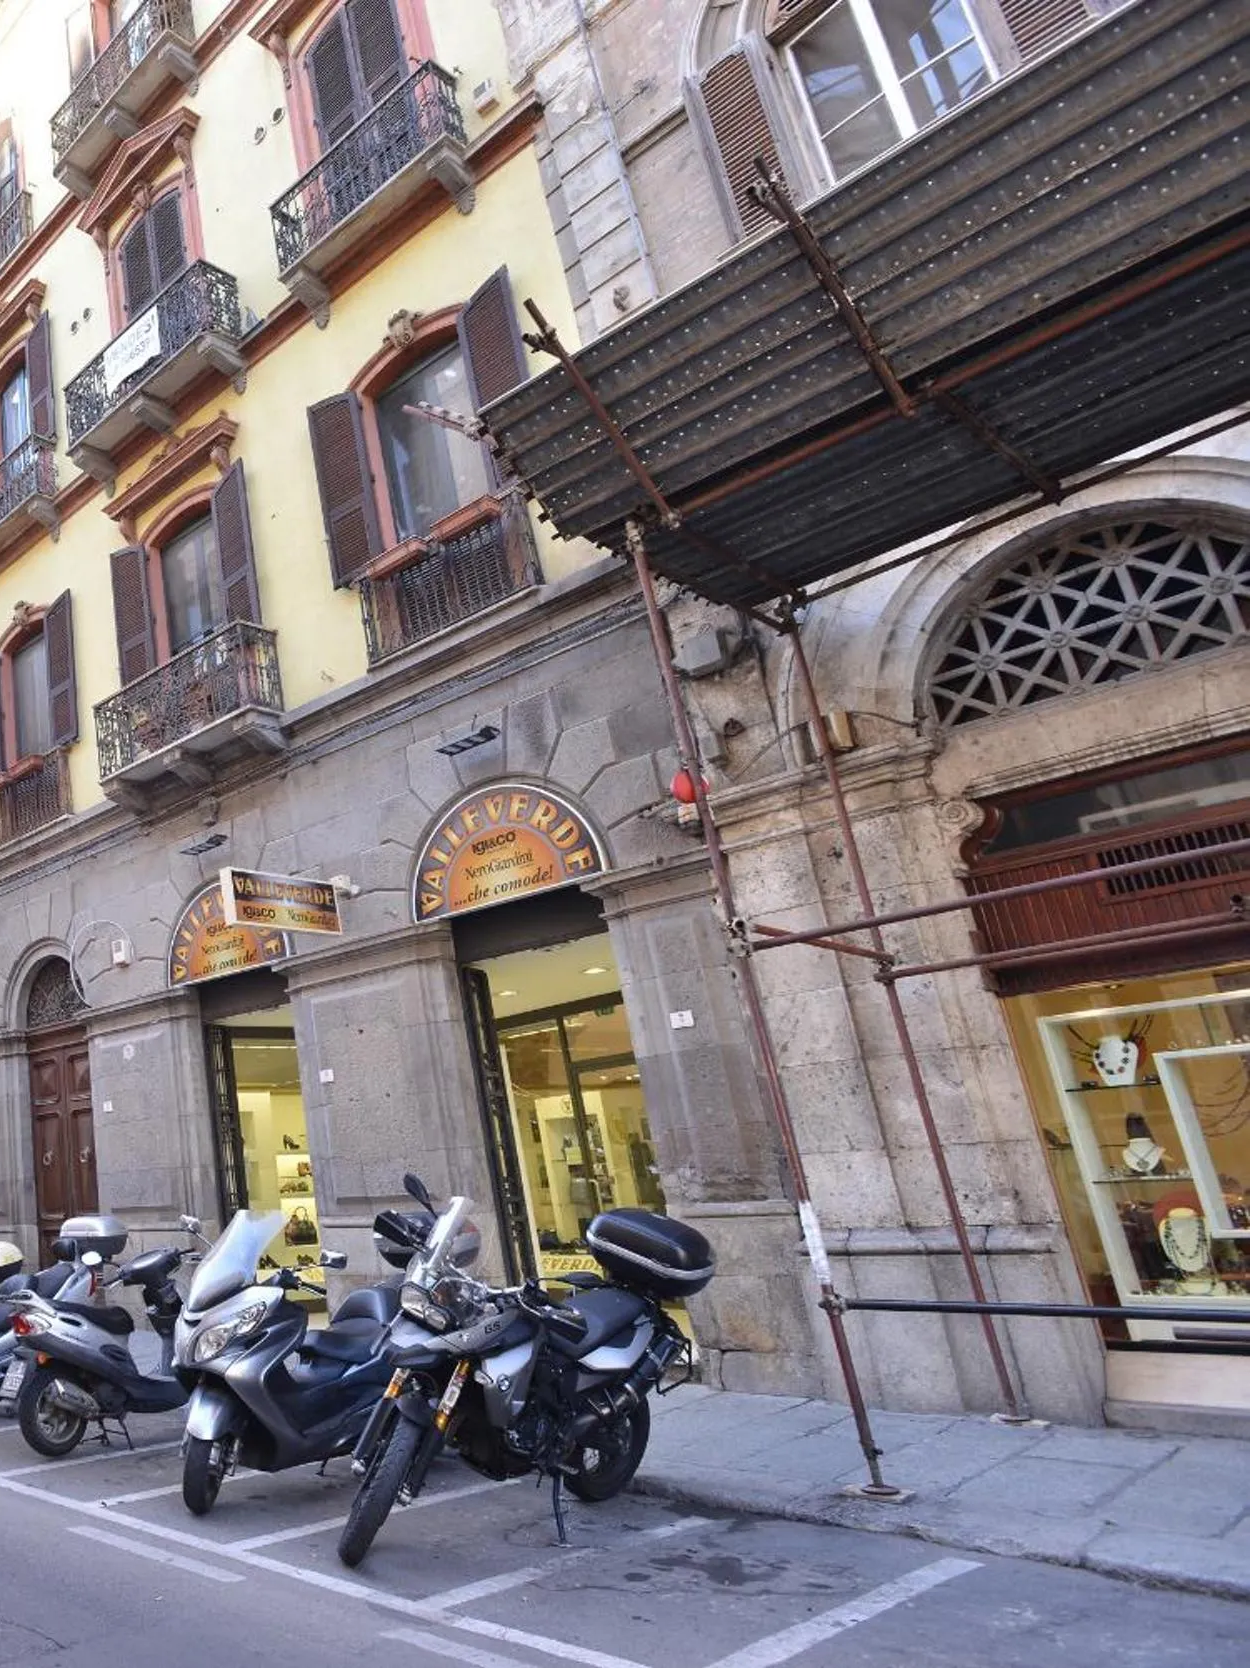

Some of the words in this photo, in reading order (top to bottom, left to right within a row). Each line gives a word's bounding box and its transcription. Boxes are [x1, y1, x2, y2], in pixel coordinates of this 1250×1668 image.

[421, 792, 595, 914] VALLEVERDE
[233, 875, 335, 905] VALLEVERDE
[494, 863, 554, 894] comode!
[484, 1321, 501, 1334] GS
